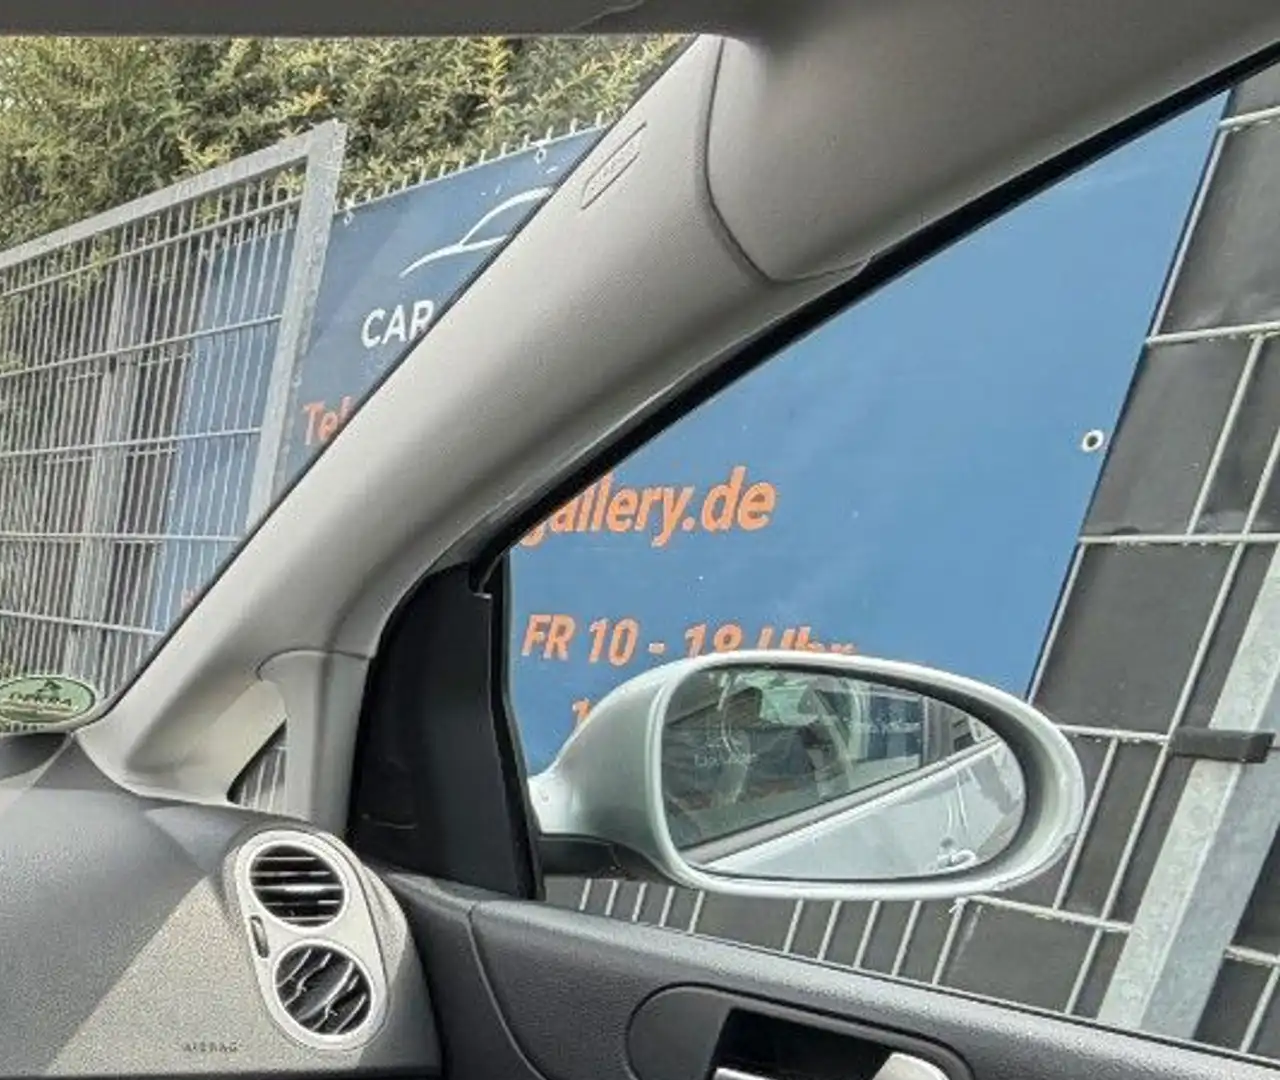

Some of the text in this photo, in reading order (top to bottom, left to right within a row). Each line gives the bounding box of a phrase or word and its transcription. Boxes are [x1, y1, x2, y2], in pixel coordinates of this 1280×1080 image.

[360, 300, 435, 349] CAR
[521, 613, 577, 661] FR
[589, 618, 639, 666] 10
